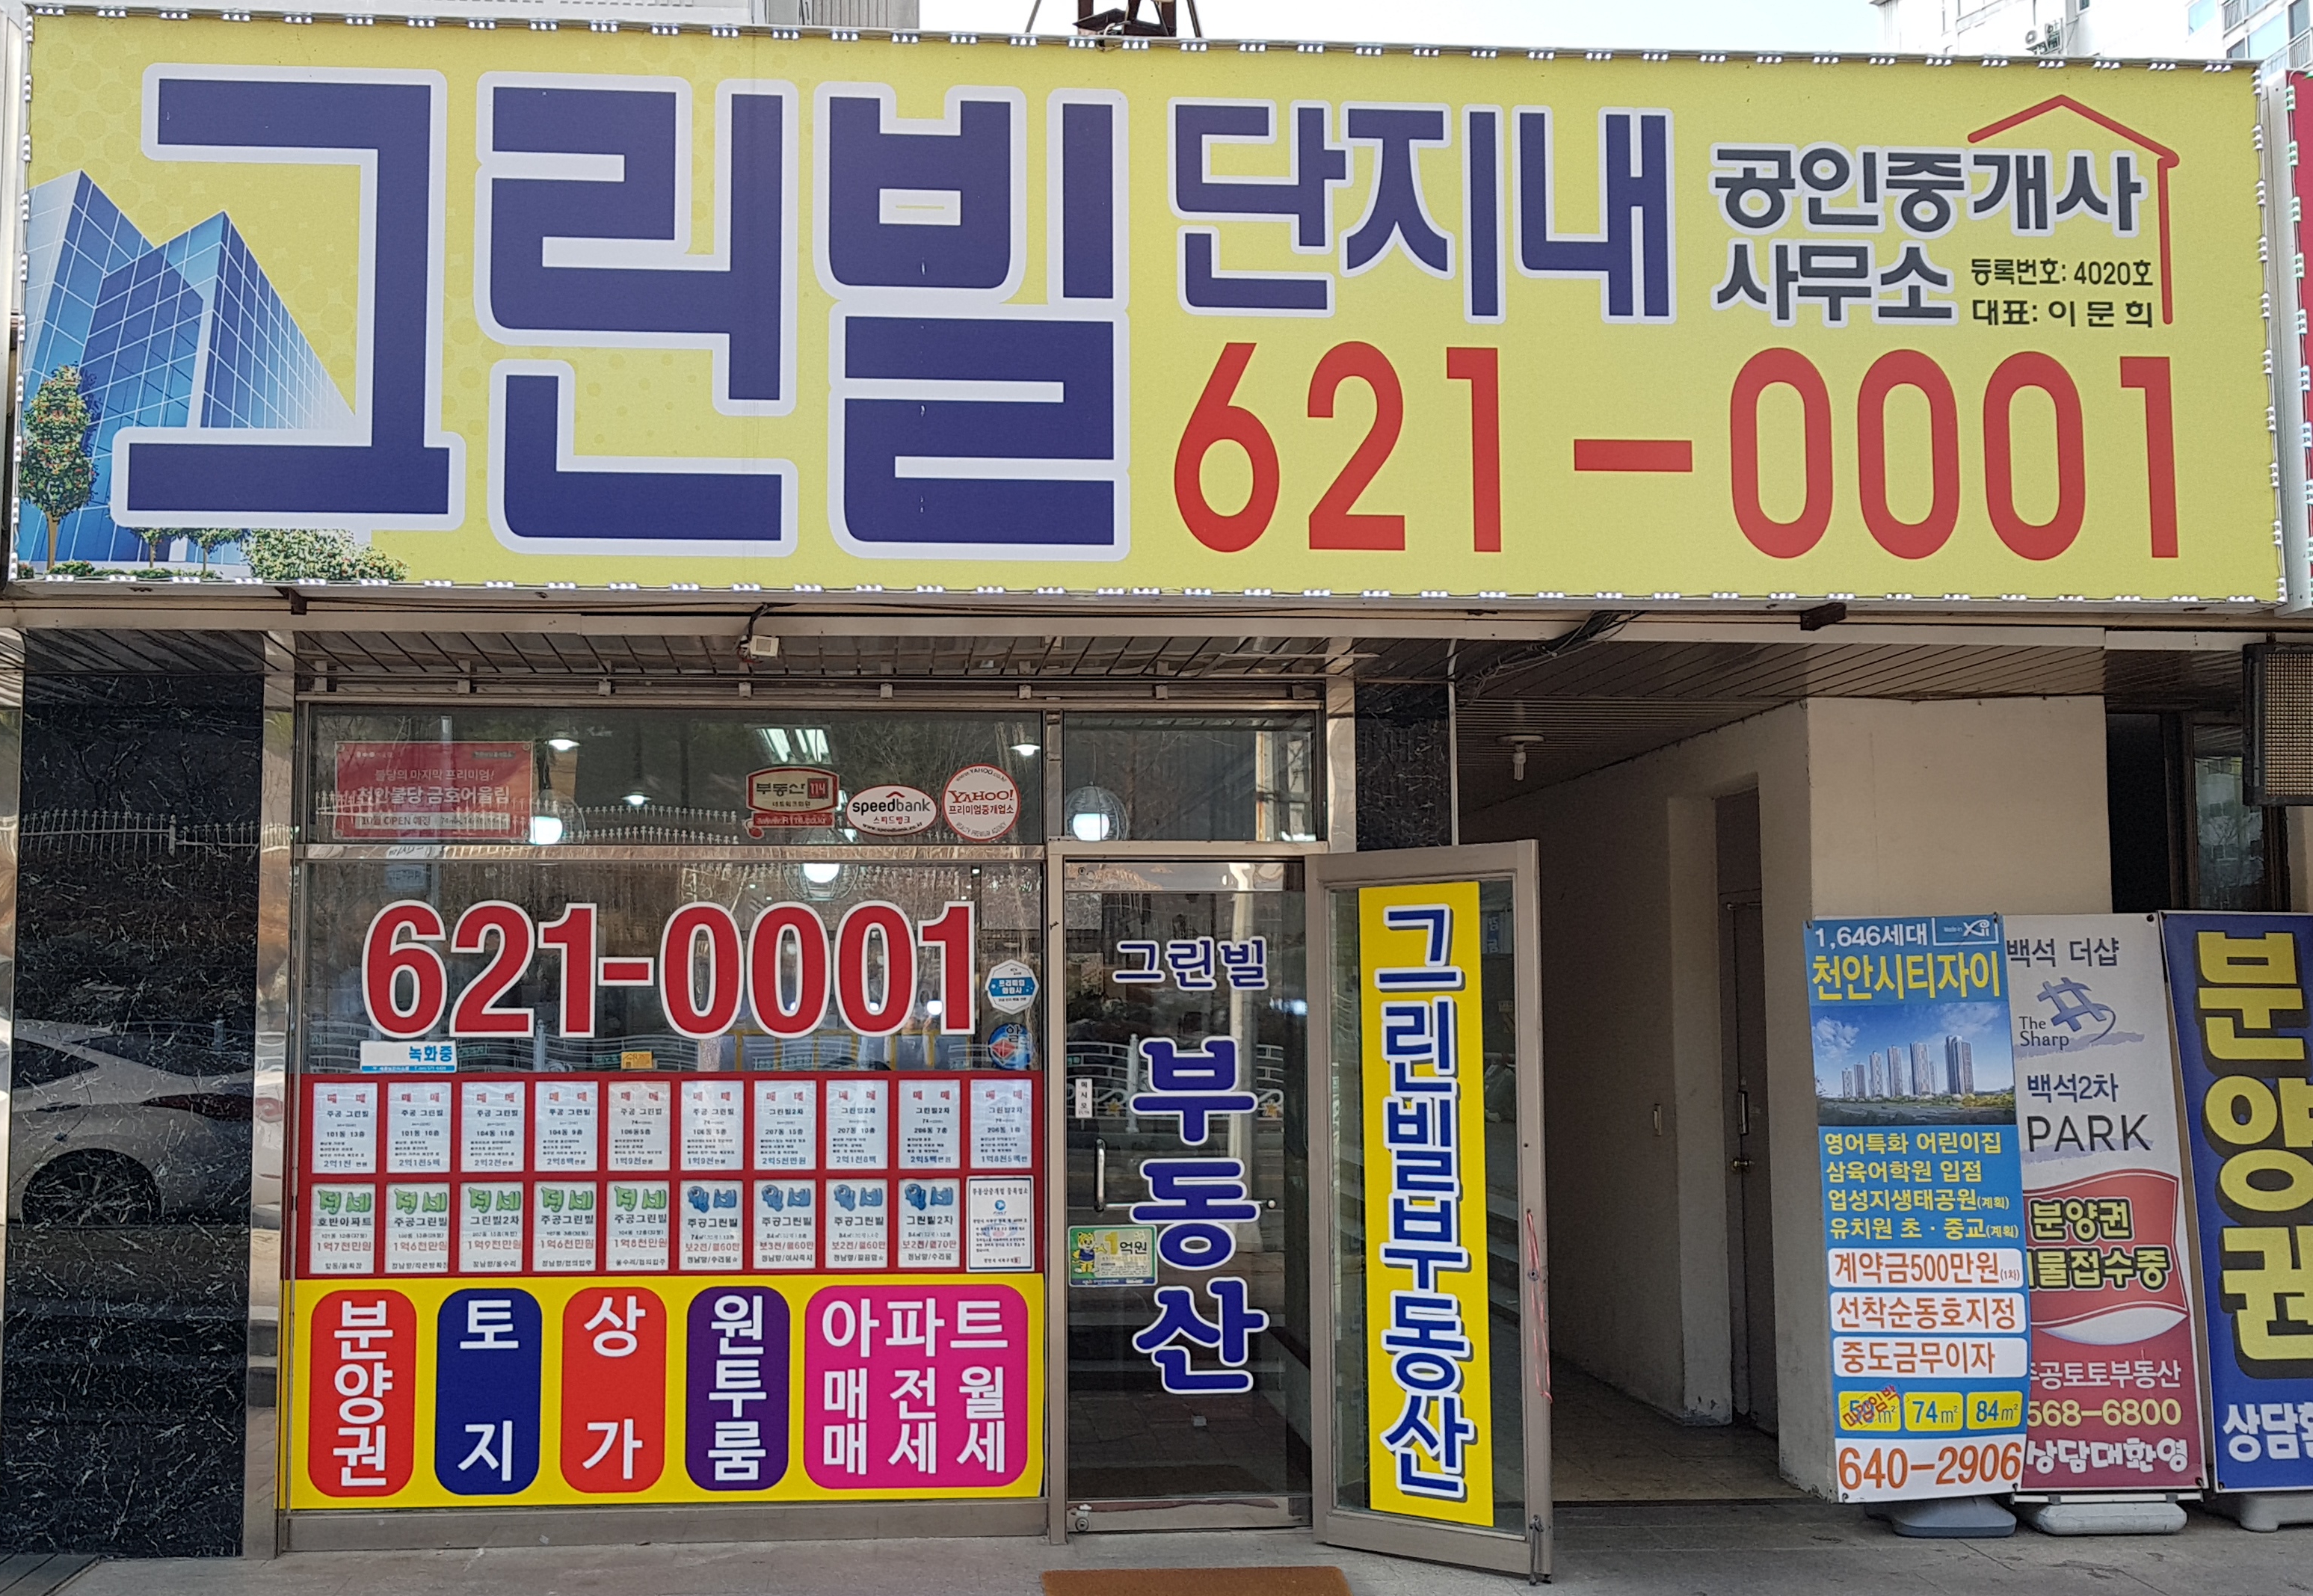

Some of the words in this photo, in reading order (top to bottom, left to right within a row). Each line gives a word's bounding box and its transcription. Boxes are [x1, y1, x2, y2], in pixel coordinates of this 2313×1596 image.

[1714, 148, 2142, 232] 공인중개사
[1172, 103, 1671, 318] 단지내
[1716, 244, 1953, 321] 사무소
[1971, 259, 2066, 286] 등록번호:
[2073, 259, 2153, 286] 4020호
[126, 78, 1115, 546] 그린빌
[1972, 300, 2037, 326] 대표:
[1172, 339, 2180, 561] 621-0001
[411, 770, 443, 781] 마지막
[428, 786, 510, 804] 금호어울림
[757, 783, 805, 796] 부동산
[384, 816, 410, 825] OPEN
[852, 798, 930, 816] speedbank
[949, 804, 1014, 815] 프리미엄중개업소
[1815, 923, 1928, 950] 1,646세대
[1114, 937, 1267, 990] 그린빌
[2006, 938, 2056, 967] 백석
[2070, 937, 2119, 967] 더샵
[366, 902, 975, 1038] 621-0001
[1812, 950, 2001, 1001] 천안시티자이
[2018, 1017, 2046, 1030] The
[409, 1046, 452, 1062] 녹화중
[2020, 1031, 2069, 1050] Sharp
[2027, 1073, 2119, 1103] 백석2차
[1824, 1133, 1909, 1154] 영어특화
[1917, 1132, 2002, 1154] 어린이집
[2027, 1114, 2152, 1153] PARK
[1826, 1160, 1932, 1183] 삼육어학원
[1941, 1160, 1982, 1183] 입점
[317, 1217, 372, 1227] 호반아파트
[394, 1217, 447, 1227] 주공그린빌
[470, 1215, 520, 1225] 그린빌2차
[541, 1215, 594, 1225] 주공그린빌
[615, 1214, 667, 1224] 주공그린빌
[688, 1218, 738, 1228] 주공그린빌
[762, 1216, 812, 1227] 주공그린빌
[834, 1216, 884, 1226] 주공그린빌
[906, 1216, 953, 1225] 그린빌2차
[1132, 1037, 1268, 1393] 부동산
[1830, 1218, 1892, 1239] 유치원
[2032, 1200, 2130, 1239] 분양권
[317, 1242, 372, 1251] 1억7천만원
[2027, 1249, 2169, 1287] 물접수중
[1837, 1296, 2015, 1329] 선착순동호지정
[822, 1298, 1008, 1358] 아파트
[1841, 1342, 1995, 1374] 중도금무이자
[332, 1298, 395, 1488] 분양권
[458, 1298, 519, 1483] 토지
[581, 1294, 646, 1481] 상가
[707, 1294, 767, 1482] 원투룸
[1838, 1443, 2022, 1491] 640-2906
[2027, 1438, 2188, 1474] 상담대환영
